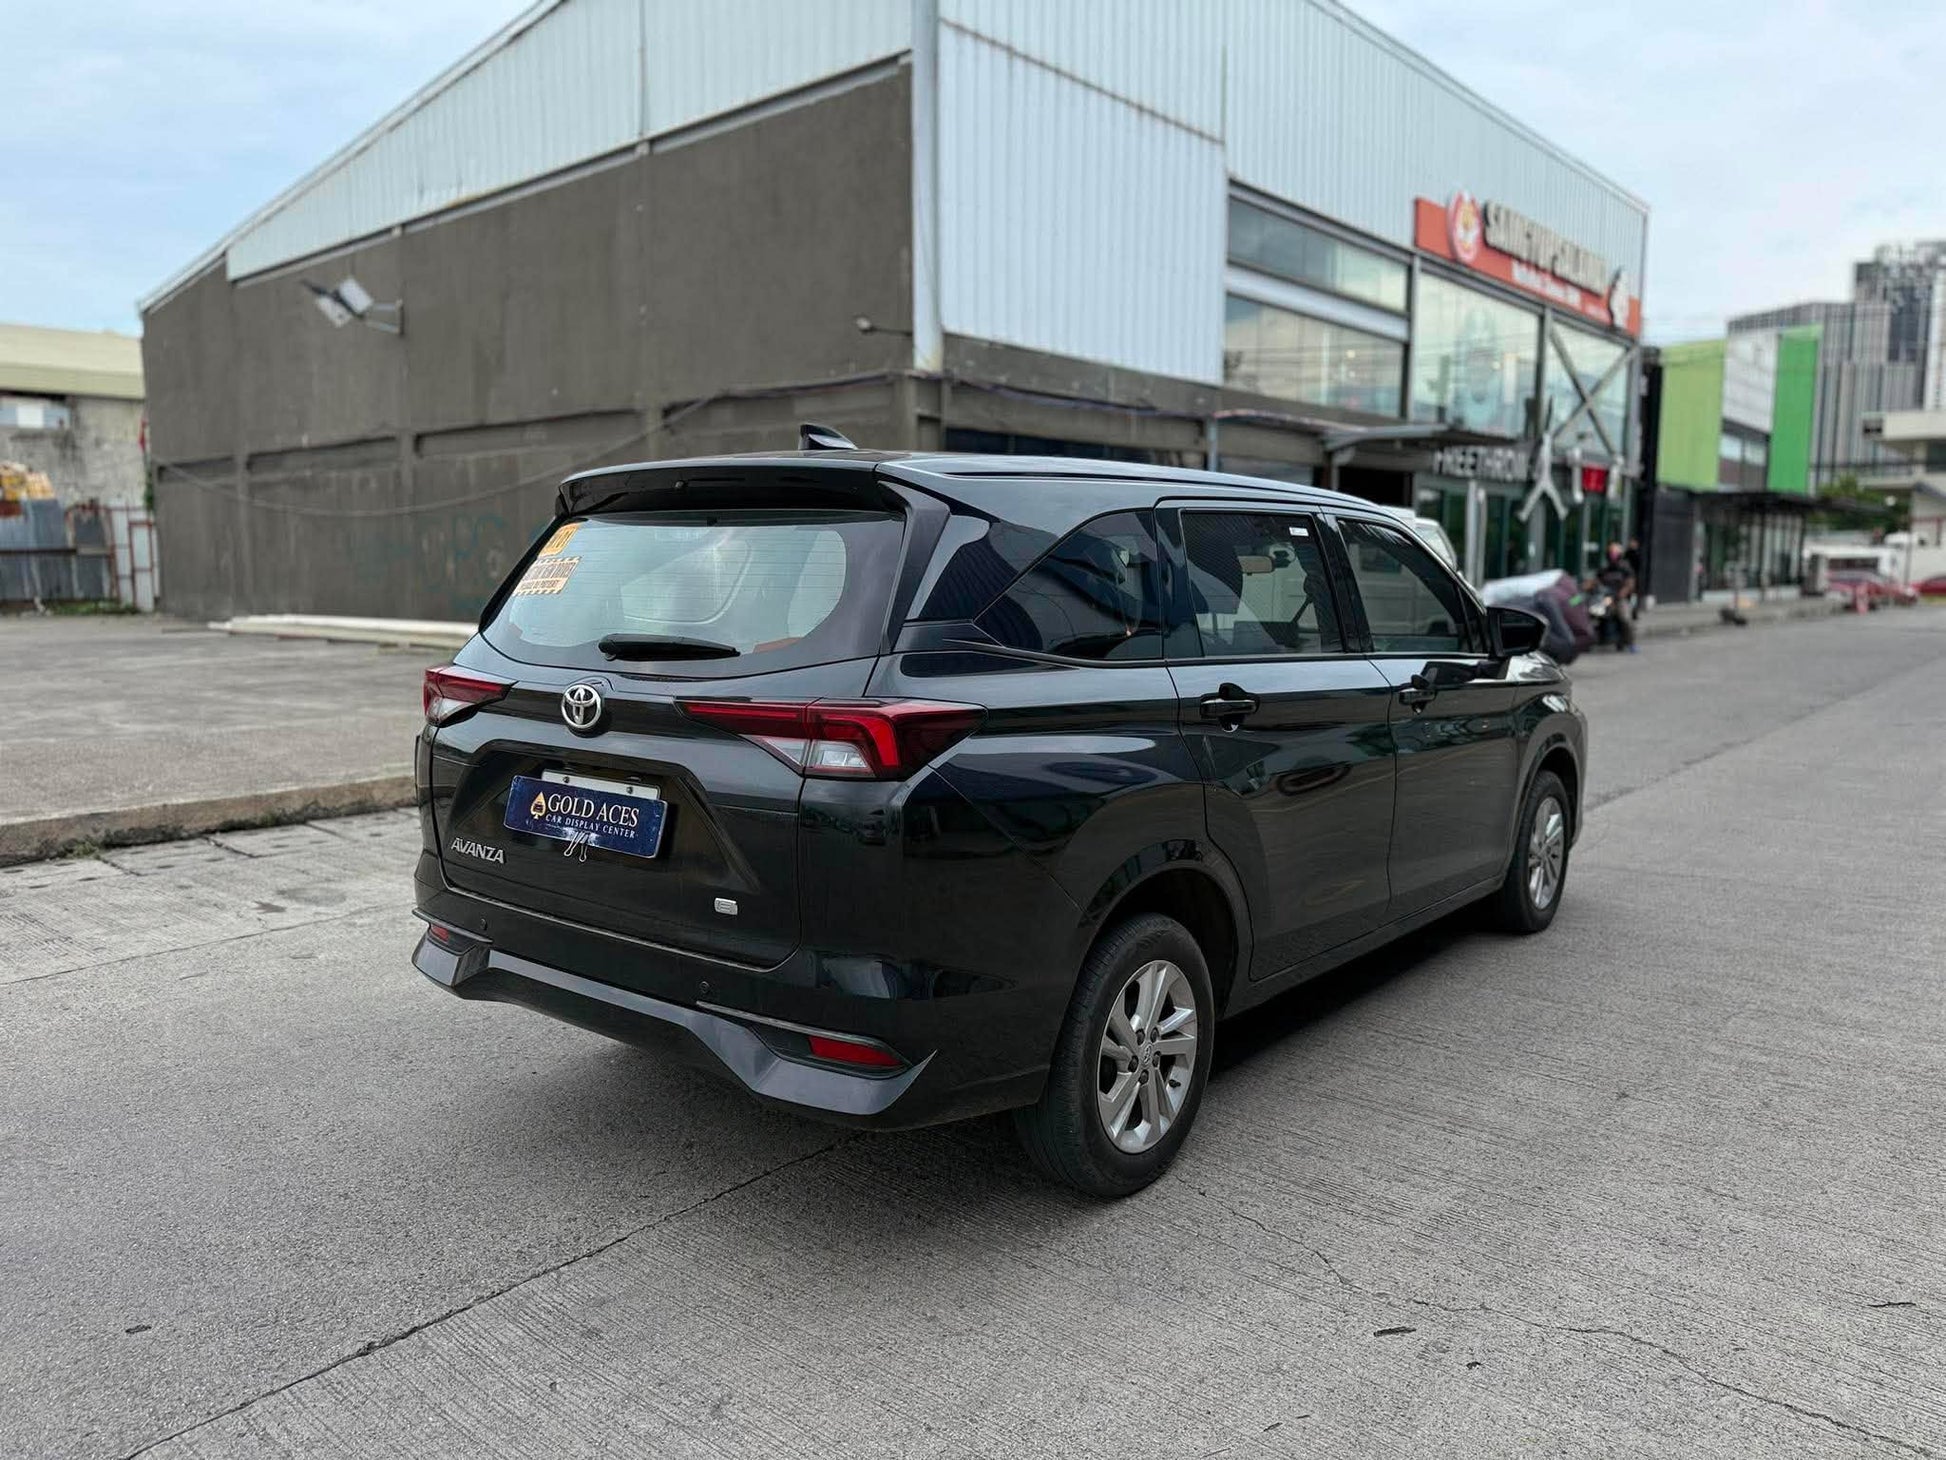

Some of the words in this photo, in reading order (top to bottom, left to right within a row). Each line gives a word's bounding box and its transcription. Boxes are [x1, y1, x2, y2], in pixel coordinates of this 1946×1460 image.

[548, 793, 595, 818] GOLD
[596, 802, 640, 828] ACES
[545, 813, 562, 824] CAR
[565, 817, 600, 831] DISPLAY
[602, 824, 636, 839] CENTER
[450, 837, 505, 864] AVANZA
